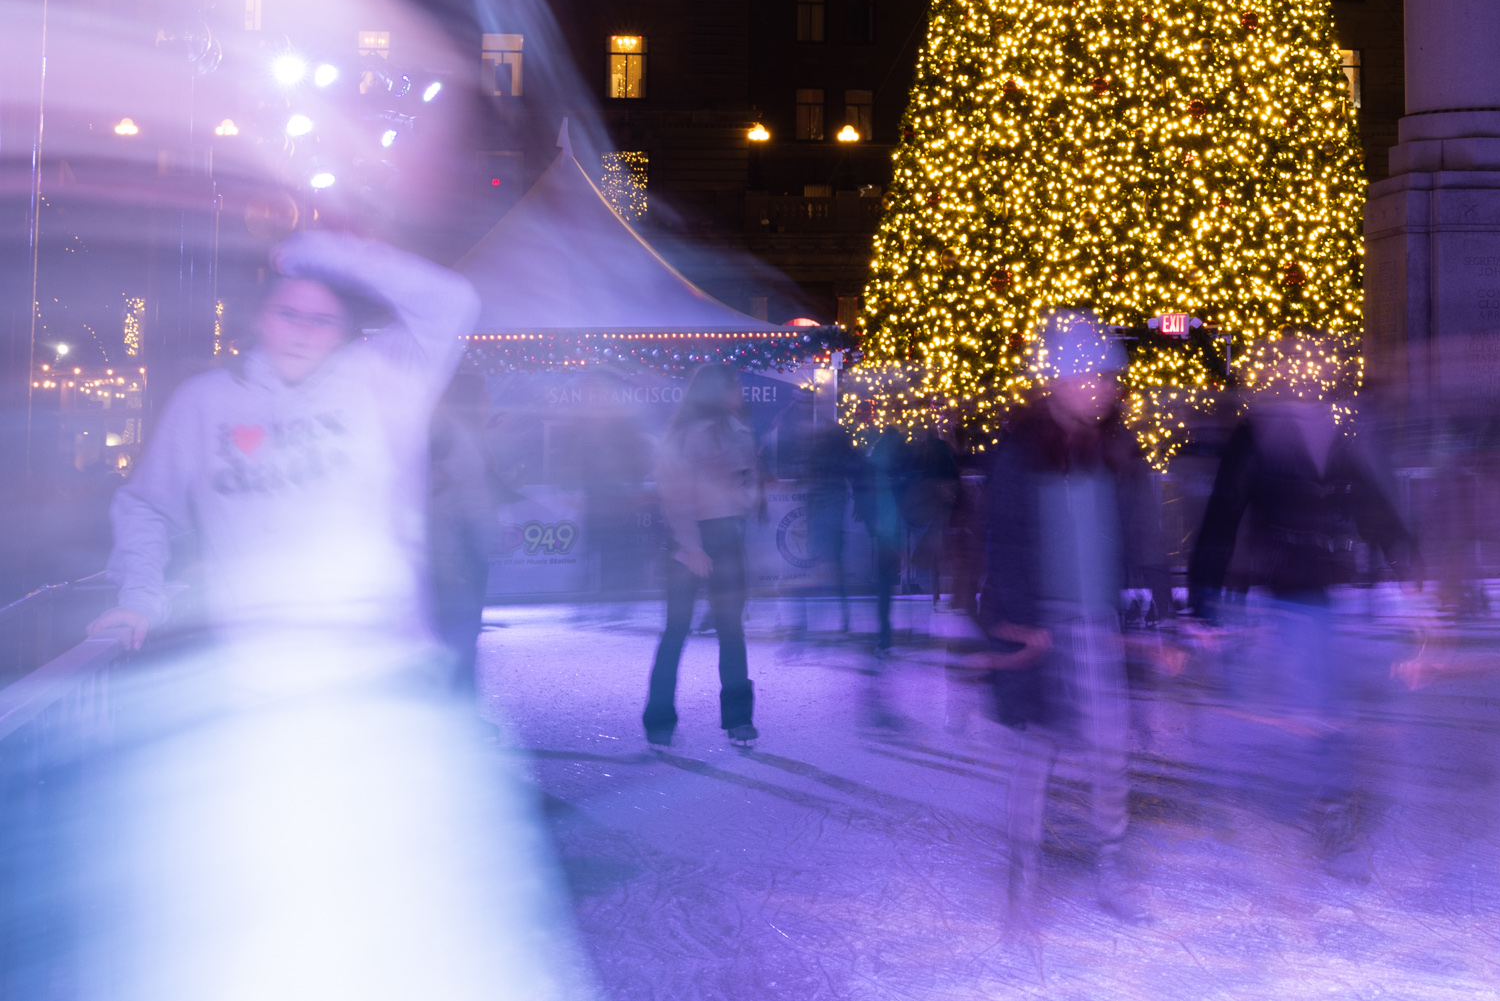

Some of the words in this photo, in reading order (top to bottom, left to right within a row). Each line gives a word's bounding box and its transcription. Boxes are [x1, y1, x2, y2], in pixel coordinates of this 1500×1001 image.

[1162, 314, 1186, 333] EXIT
[549, 387, 582, 404] SAN
[588, 386, 683, 404] FRANCISCO
[738, 386, 777, 402] ERE!
[549, 557, 577, 565] Station
